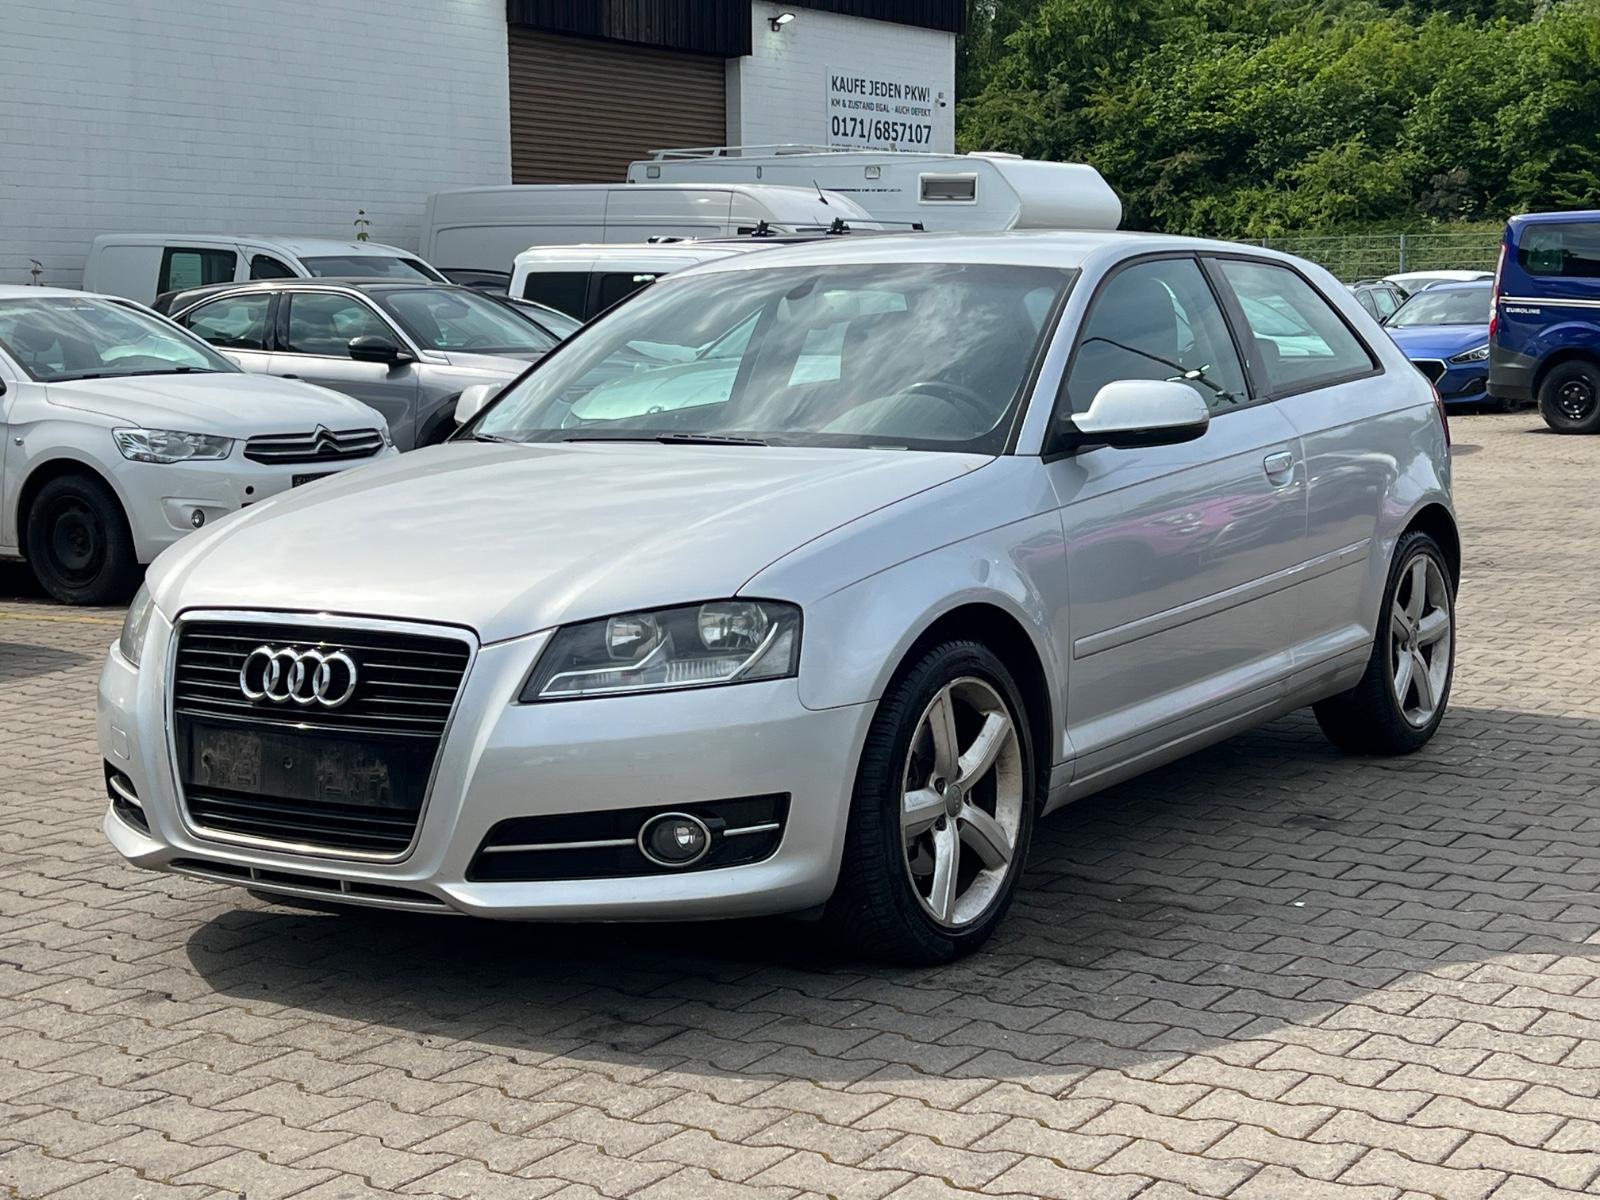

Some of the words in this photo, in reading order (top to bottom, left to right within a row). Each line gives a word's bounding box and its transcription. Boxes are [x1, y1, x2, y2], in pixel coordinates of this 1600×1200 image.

[831, 75, 866, 96] KAUFE
[868, 80, 901, 99] JEDEN
[904, 85, 930, 102] PKW!
[848, 100, 875, 111] ZUSTAND
[876, 104, 890, 113] EGAL
[895, 105, 909, 115] AUCH
[911, 107, 931, 117] DEFEKT
[831, 115, 932, 144] 0171/6857107
[1506, 307, 1541, 315] EUROLINE
